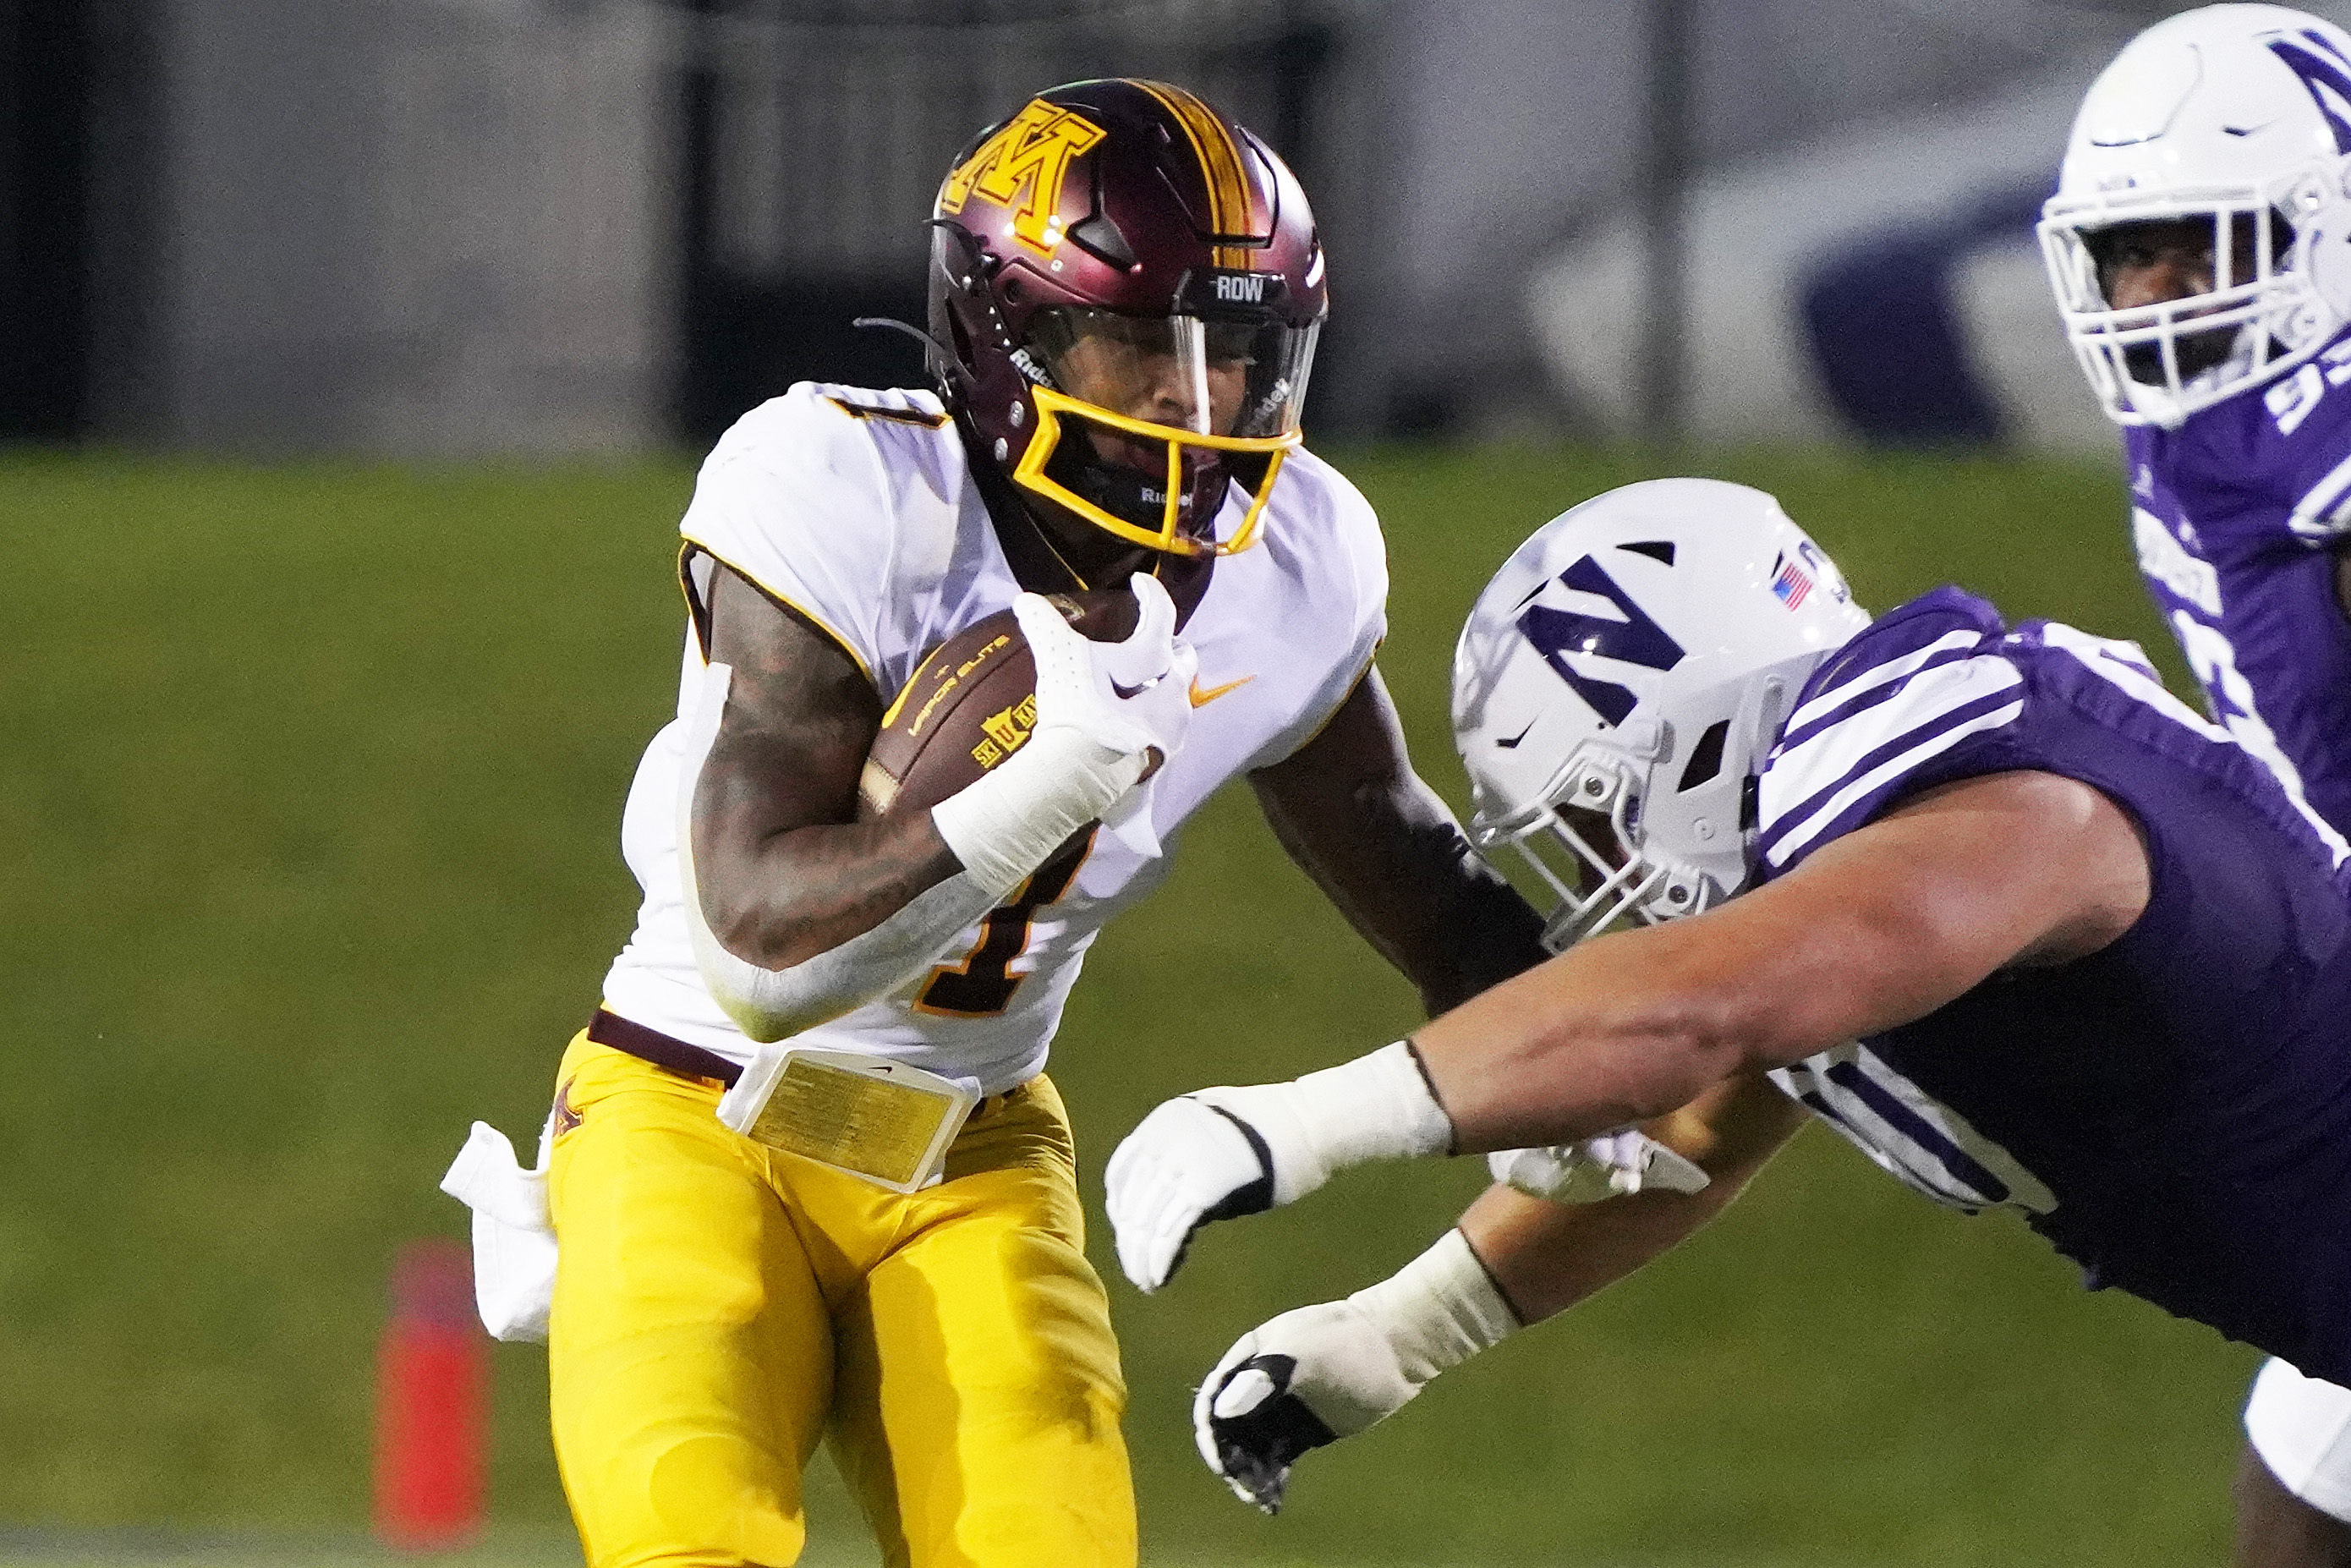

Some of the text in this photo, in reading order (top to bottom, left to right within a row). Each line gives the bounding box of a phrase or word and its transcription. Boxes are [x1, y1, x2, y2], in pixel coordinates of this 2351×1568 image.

[940, 98, 1108, 260] M
[1218, 275, 1264, 303] ROW
[956, 634, 1011, 678] ELITE
[1516, 553, 1686, 727] N
[995, 723, 1016, 744] U
[913, 817, 1102, 1018] 1
